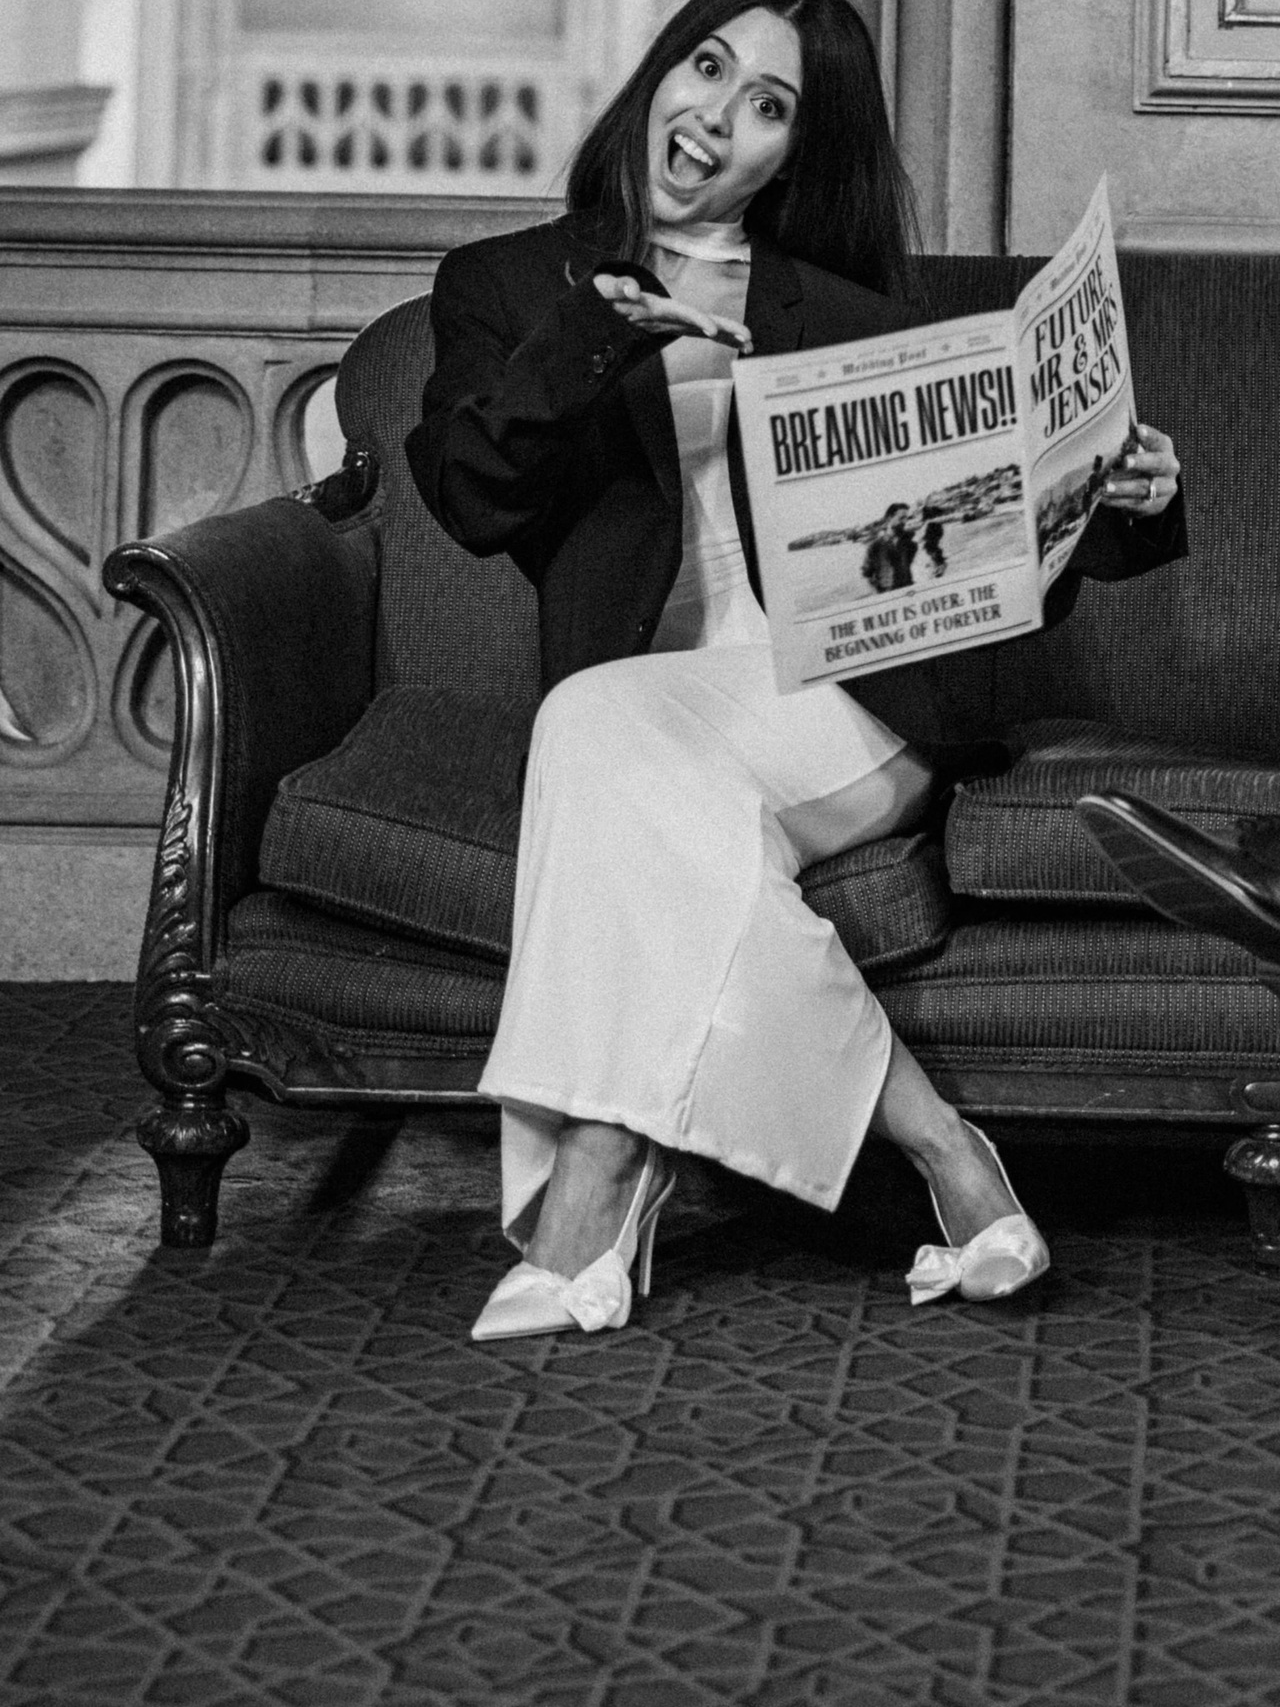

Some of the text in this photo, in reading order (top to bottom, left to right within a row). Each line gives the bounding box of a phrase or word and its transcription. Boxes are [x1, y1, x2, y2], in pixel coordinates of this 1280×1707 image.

[1035, 254, 1107, 363] FUTURE
[1031, 352, 1064, 412] MR
[1073, 333, 1088, 375] &
[1044, 339, 1121, 438] JENSEN
[770, 365, 1018, 476] BREAKING NEWS!!
[824, 603, 1003, 663] BEGINNING OF FOREVER
[829, 620, 858, 641] THE
[862, 608, 899, 632] WAIT
[902, 604, 918, 622] IS
[968, 583, 998, 604] THE
